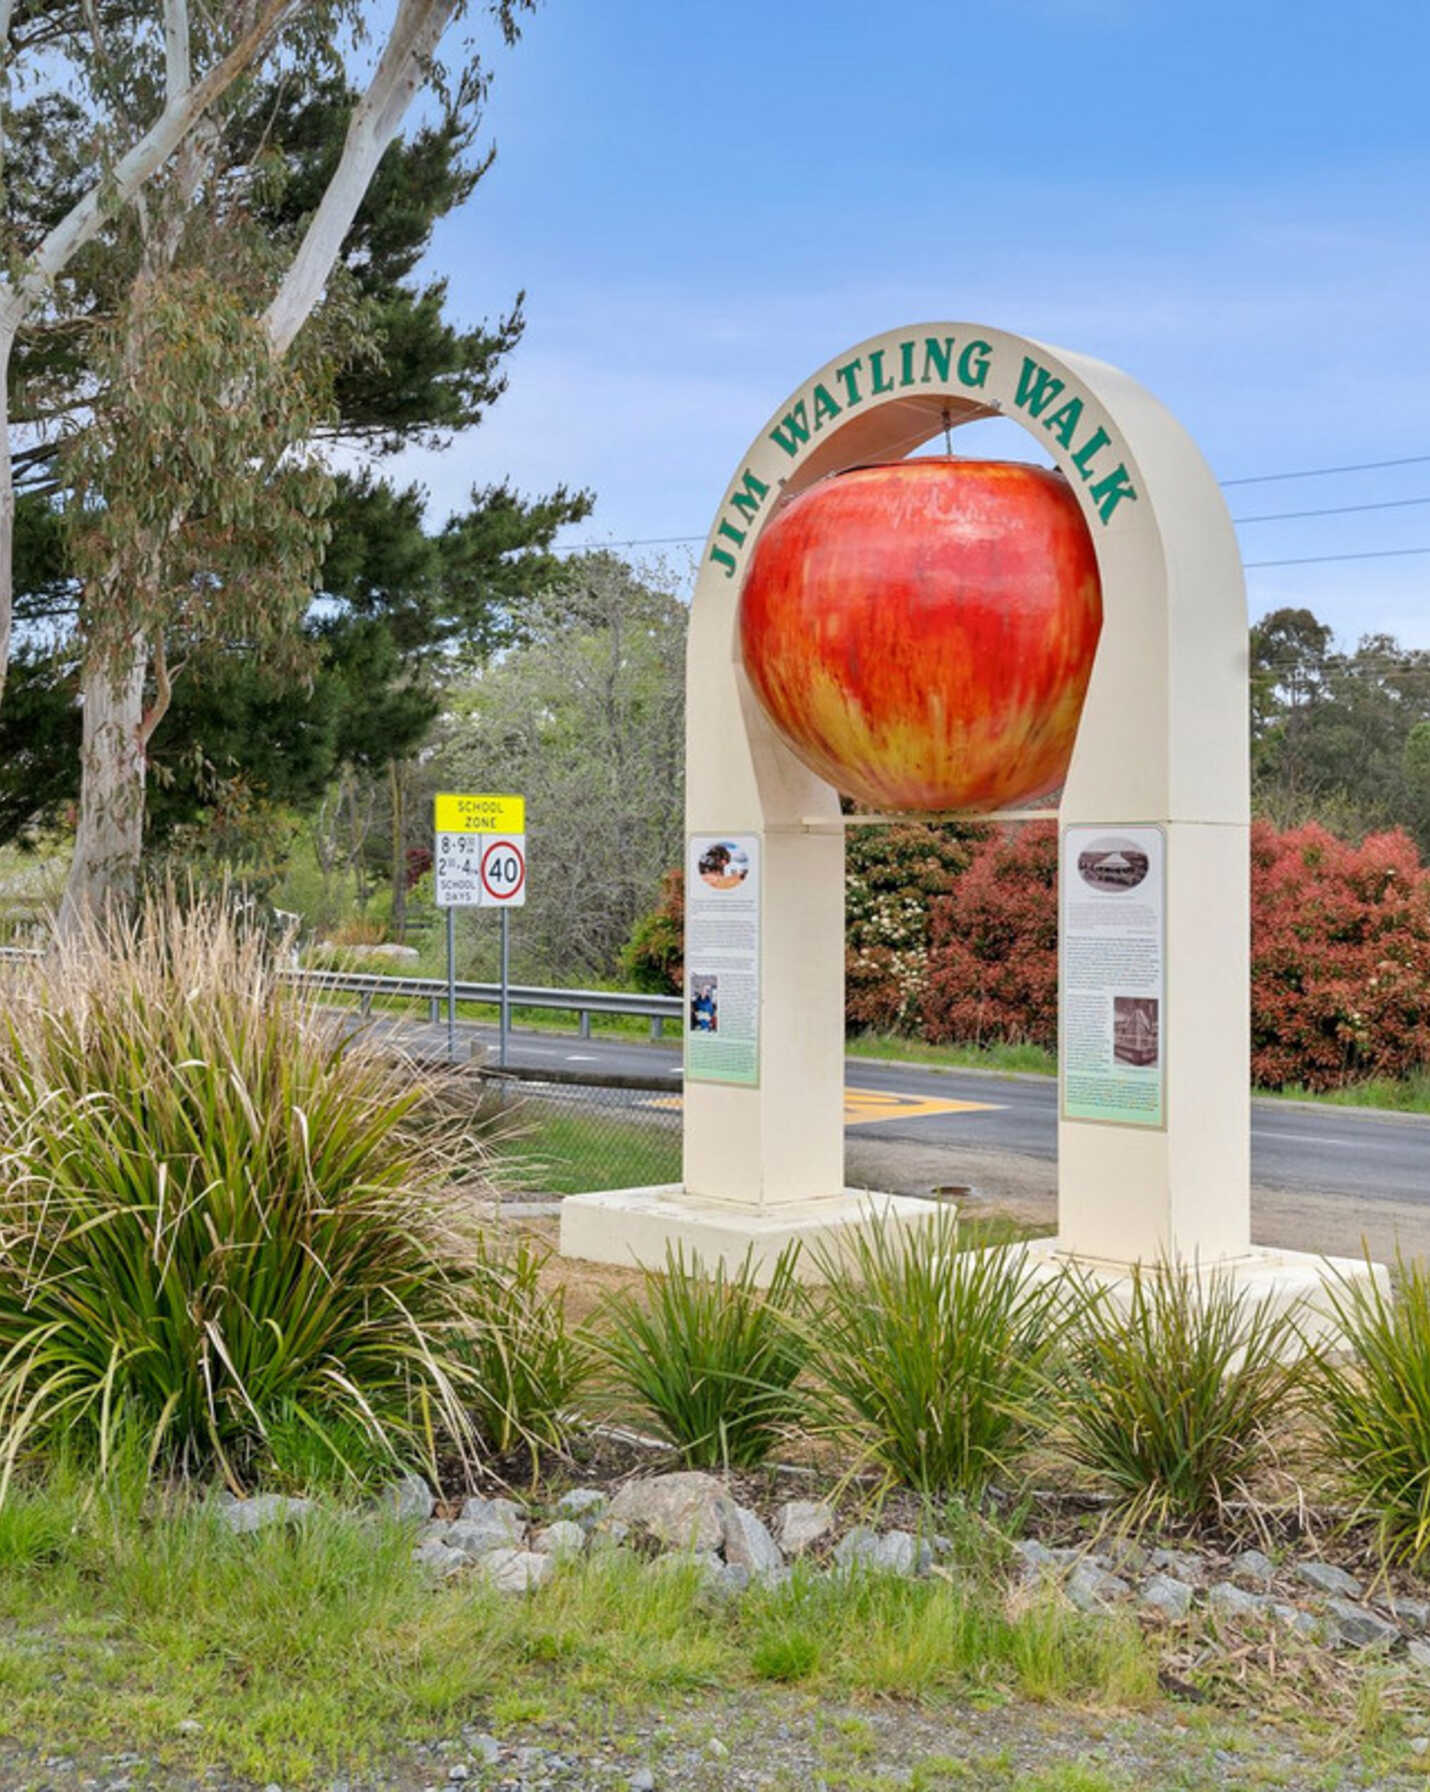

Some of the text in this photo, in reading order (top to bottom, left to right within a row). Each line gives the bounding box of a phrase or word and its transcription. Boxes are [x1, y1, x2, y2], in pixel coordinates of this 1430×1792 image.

[710, 337, 1137, 578] JIM WATLING WALK
[457, 800, 504, 814] SCHOOL
[464, 816, 497, 829] ZONE
[488, 857, 518, 883] 40
[441, 880, 476, 890] SCHOOL
[445, 892, 471, 901] DAYS
